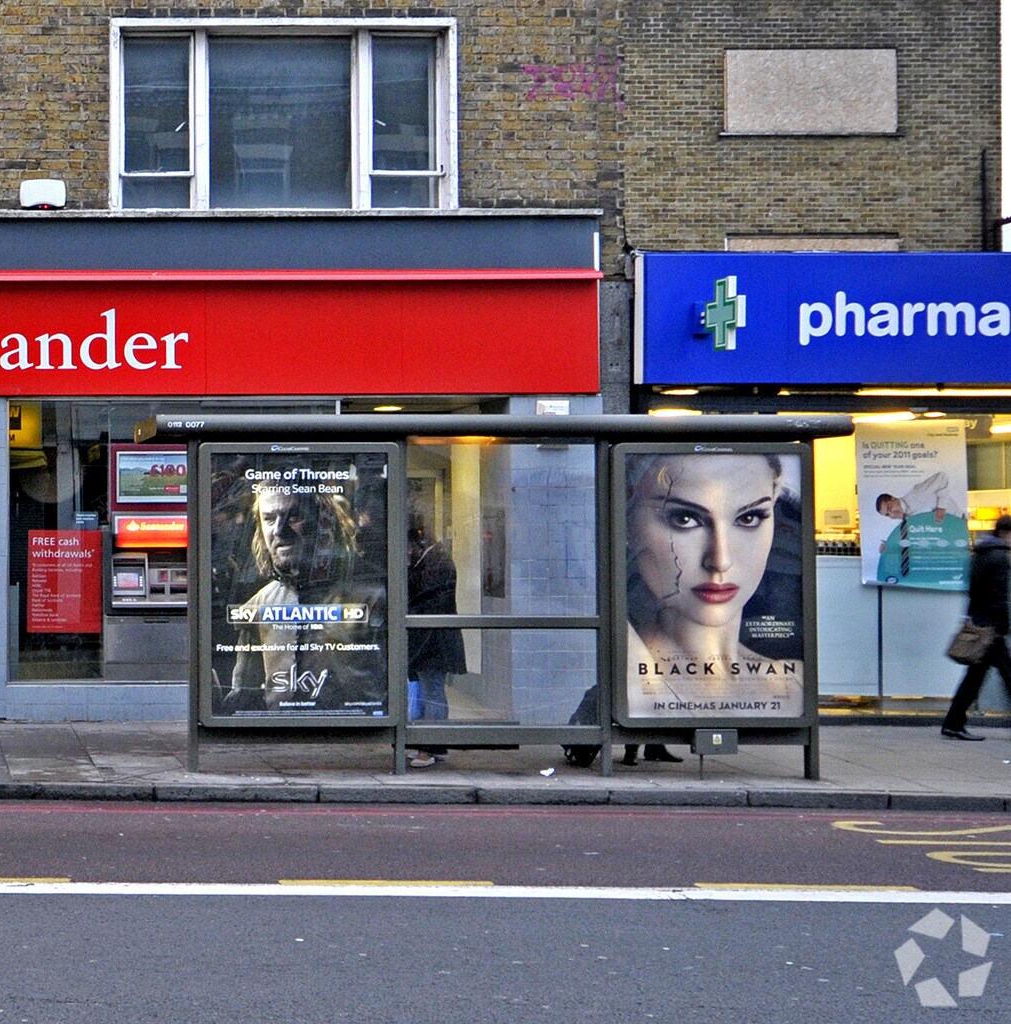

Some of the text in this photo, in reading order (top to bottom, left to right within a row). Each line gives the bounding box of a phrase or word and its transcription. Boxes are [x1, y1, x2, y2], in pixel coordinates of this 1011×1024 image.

[799, 291, 1011, 346] pharma
[862, 451, 871, 459] of
[873, 452, 891, 460] your
[912, 451, 938, 460] goals?
[149, 464, 186, 477] £100
[245, 469, 349, 480] Game of Thrones
[251, 484, 343, 495] Starring Sean Bean
[140, 521, 185, 531] Santander
[32, 537, 79, 546] FREE cash
[231, 606, 364, 623] sky ATLANTIC HD
[235, 643, 249, 651] and
[251, 643, 284, 651] exclusive
[287, 643, 297, 651] for
[300, 643, 309, 651] all
[310, 643, 323, 653] Sky
[336, 643, 380, 651] Customers.
[639, 662, 796, 675] BLACK SWAN
[272, 664, 328, 699] sky
[654, 702, 781, 711] IN CINEMAS JANUARY 21
